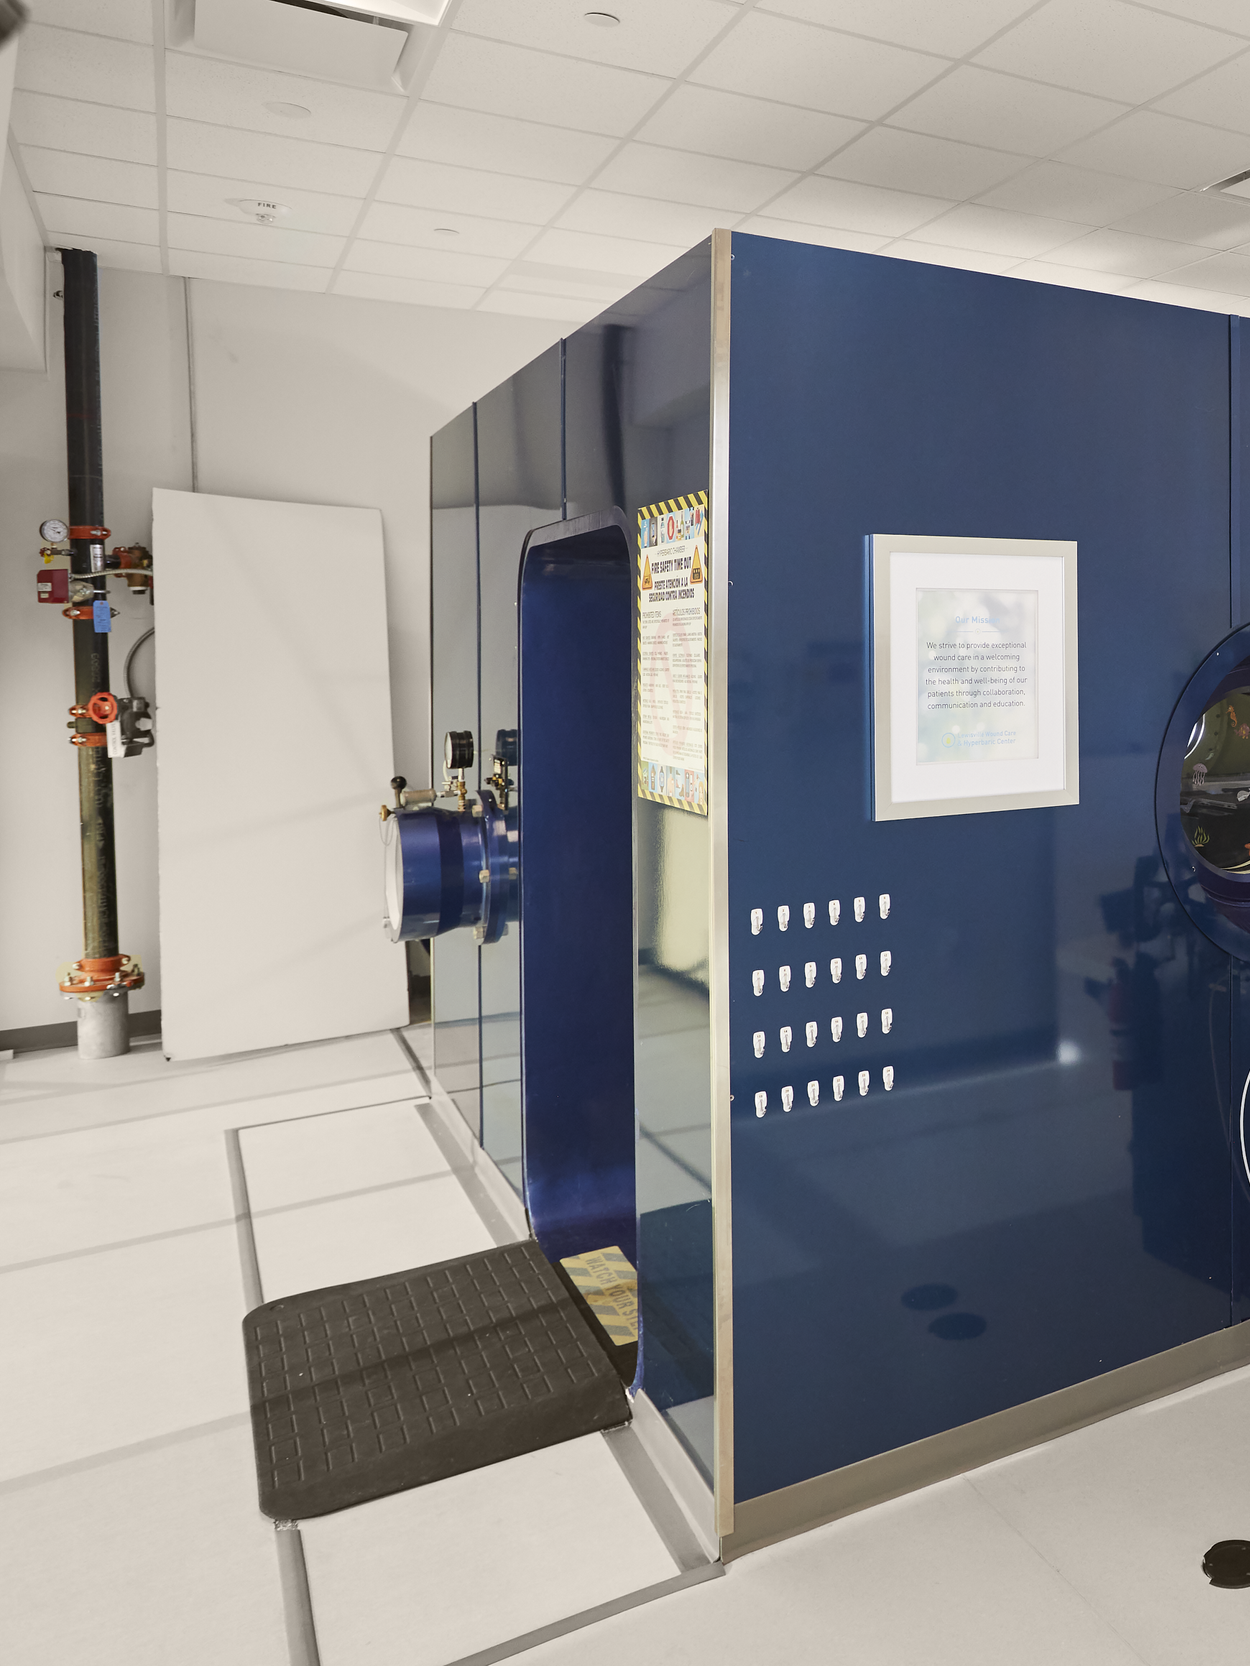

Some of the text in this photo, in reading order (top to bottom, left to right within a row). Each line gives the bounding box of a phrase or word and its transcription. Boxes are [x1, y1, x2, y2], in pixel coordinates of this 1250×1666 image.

[257, 202, 277, 210] FIRE
[660, 560, 673, 573] SAFETY
[674, 558, 683, 570] TIME
[955, 616, 969, 624] Our
[967, 642, 990, 650] provide
[991, 642, 1026, 650] exceptional
[986, 654, 1020, 662] welcoming
[971, 666, 978, 674] by
[974, 677, 1007, 685] well-being
[928, 691, 954, 699] patients
[956, 690, 981, 698] through
[964, 739, 995, 747] Hyperbaric
[585, 1255, 618, 1286] WATCH
[605, 1284, 636, 1310] YOUR
